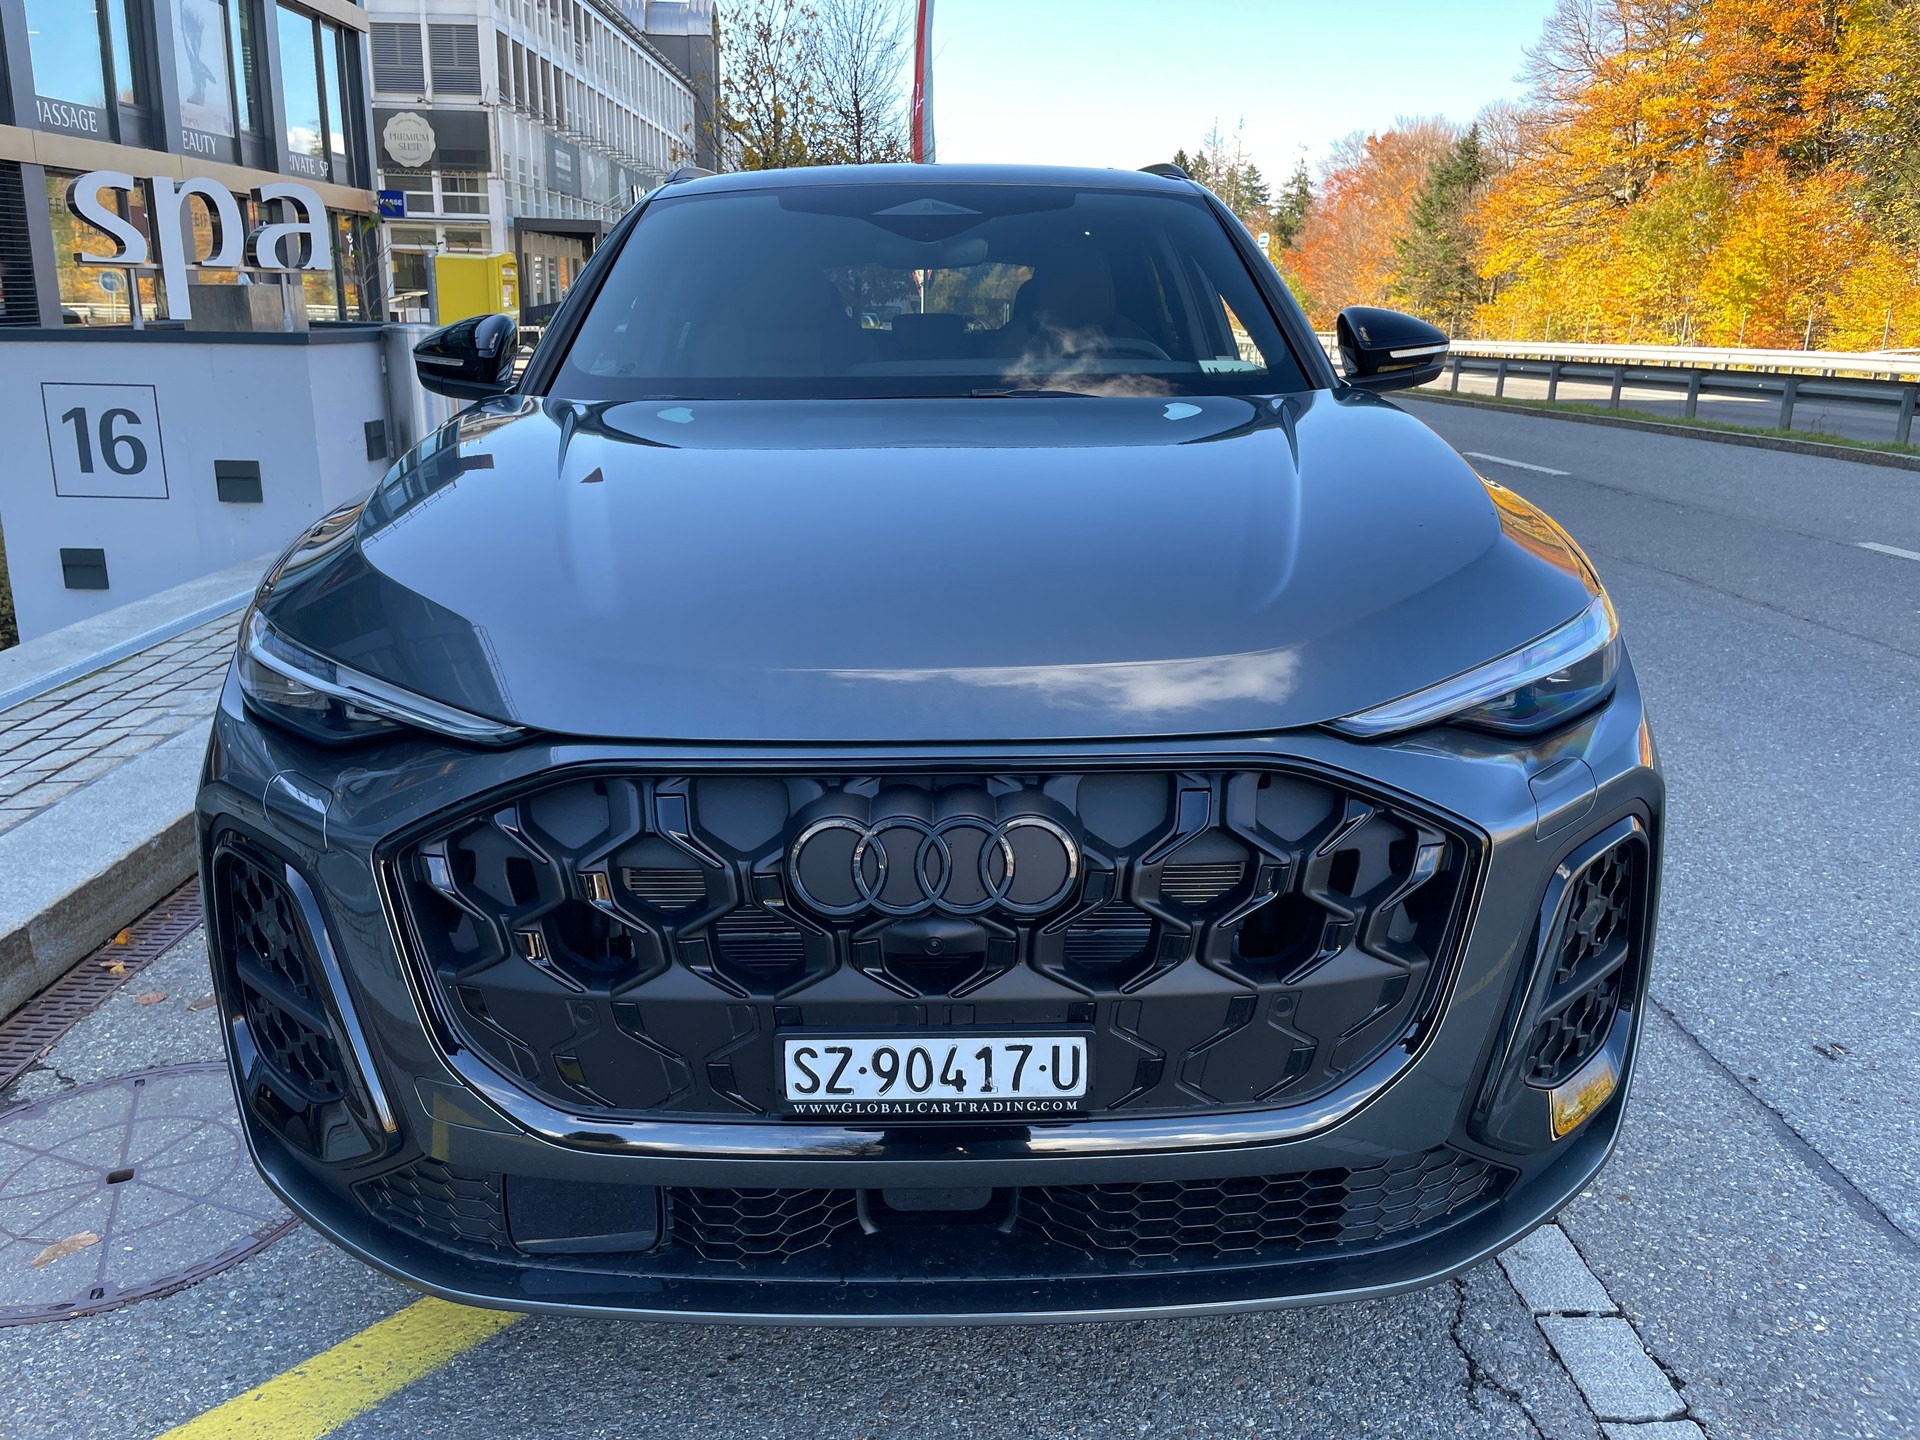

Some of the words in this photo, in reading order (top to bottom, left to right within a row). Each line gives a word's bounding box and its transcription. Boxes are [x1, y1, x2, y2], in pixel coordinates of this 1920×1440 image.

[36, 100, 98, 133] ASSAGE
[389, 132, 430, 142] PREMIUM
[397, 142, 423, 151] SHOP
[66, 170, 332, 320] spa
[62, 406, 148, 475] 16
[792, 1100, 1078, 1114] WWW.GLOBALCARTRADING.COM
